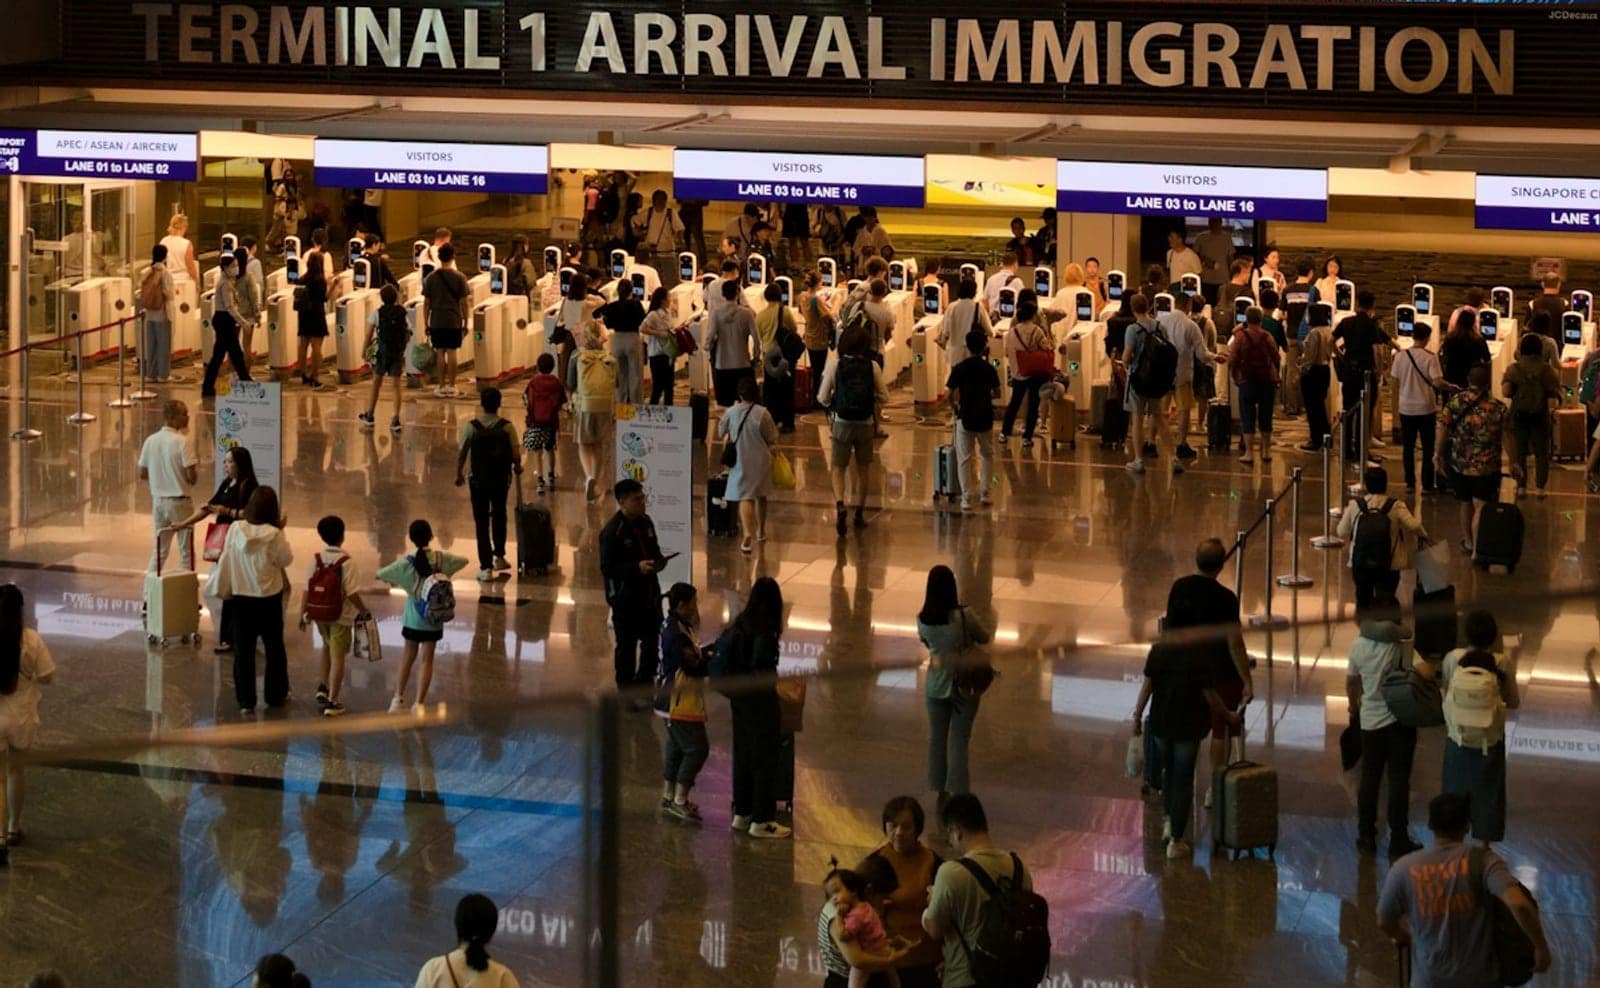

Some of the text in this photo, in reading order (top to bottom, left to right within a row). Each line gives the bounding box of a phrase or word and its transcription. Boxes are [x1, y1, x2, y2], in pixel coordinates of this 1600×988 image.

[132, 3, 1515, 95] TERMINAL 1 ARRIVAL IMMIGRATION
[56, 139, 82, 149] APEC
[90, 141, 123, 151] ASEAN
[132, 142, 178, 152] AIRCREW
[407, 151, 454, 162] VISITORS
[64, 160, 170, 175] LANE 01 to LANE 02
[772, 162, 823, 174] VISITORS
[374, 171, 486, 187] LANE 03 to LANE 16
[1163, 174, 1218, 186] VISITORS
[738, 183, 858, 200] LANE 03 to LANE 16
[1511, 186, 1587, 199] SINGAPORE
[1126, 196, 1255, 213] LANE 03 to LANE 16
[1550, 212, 1590, 225] LANE
